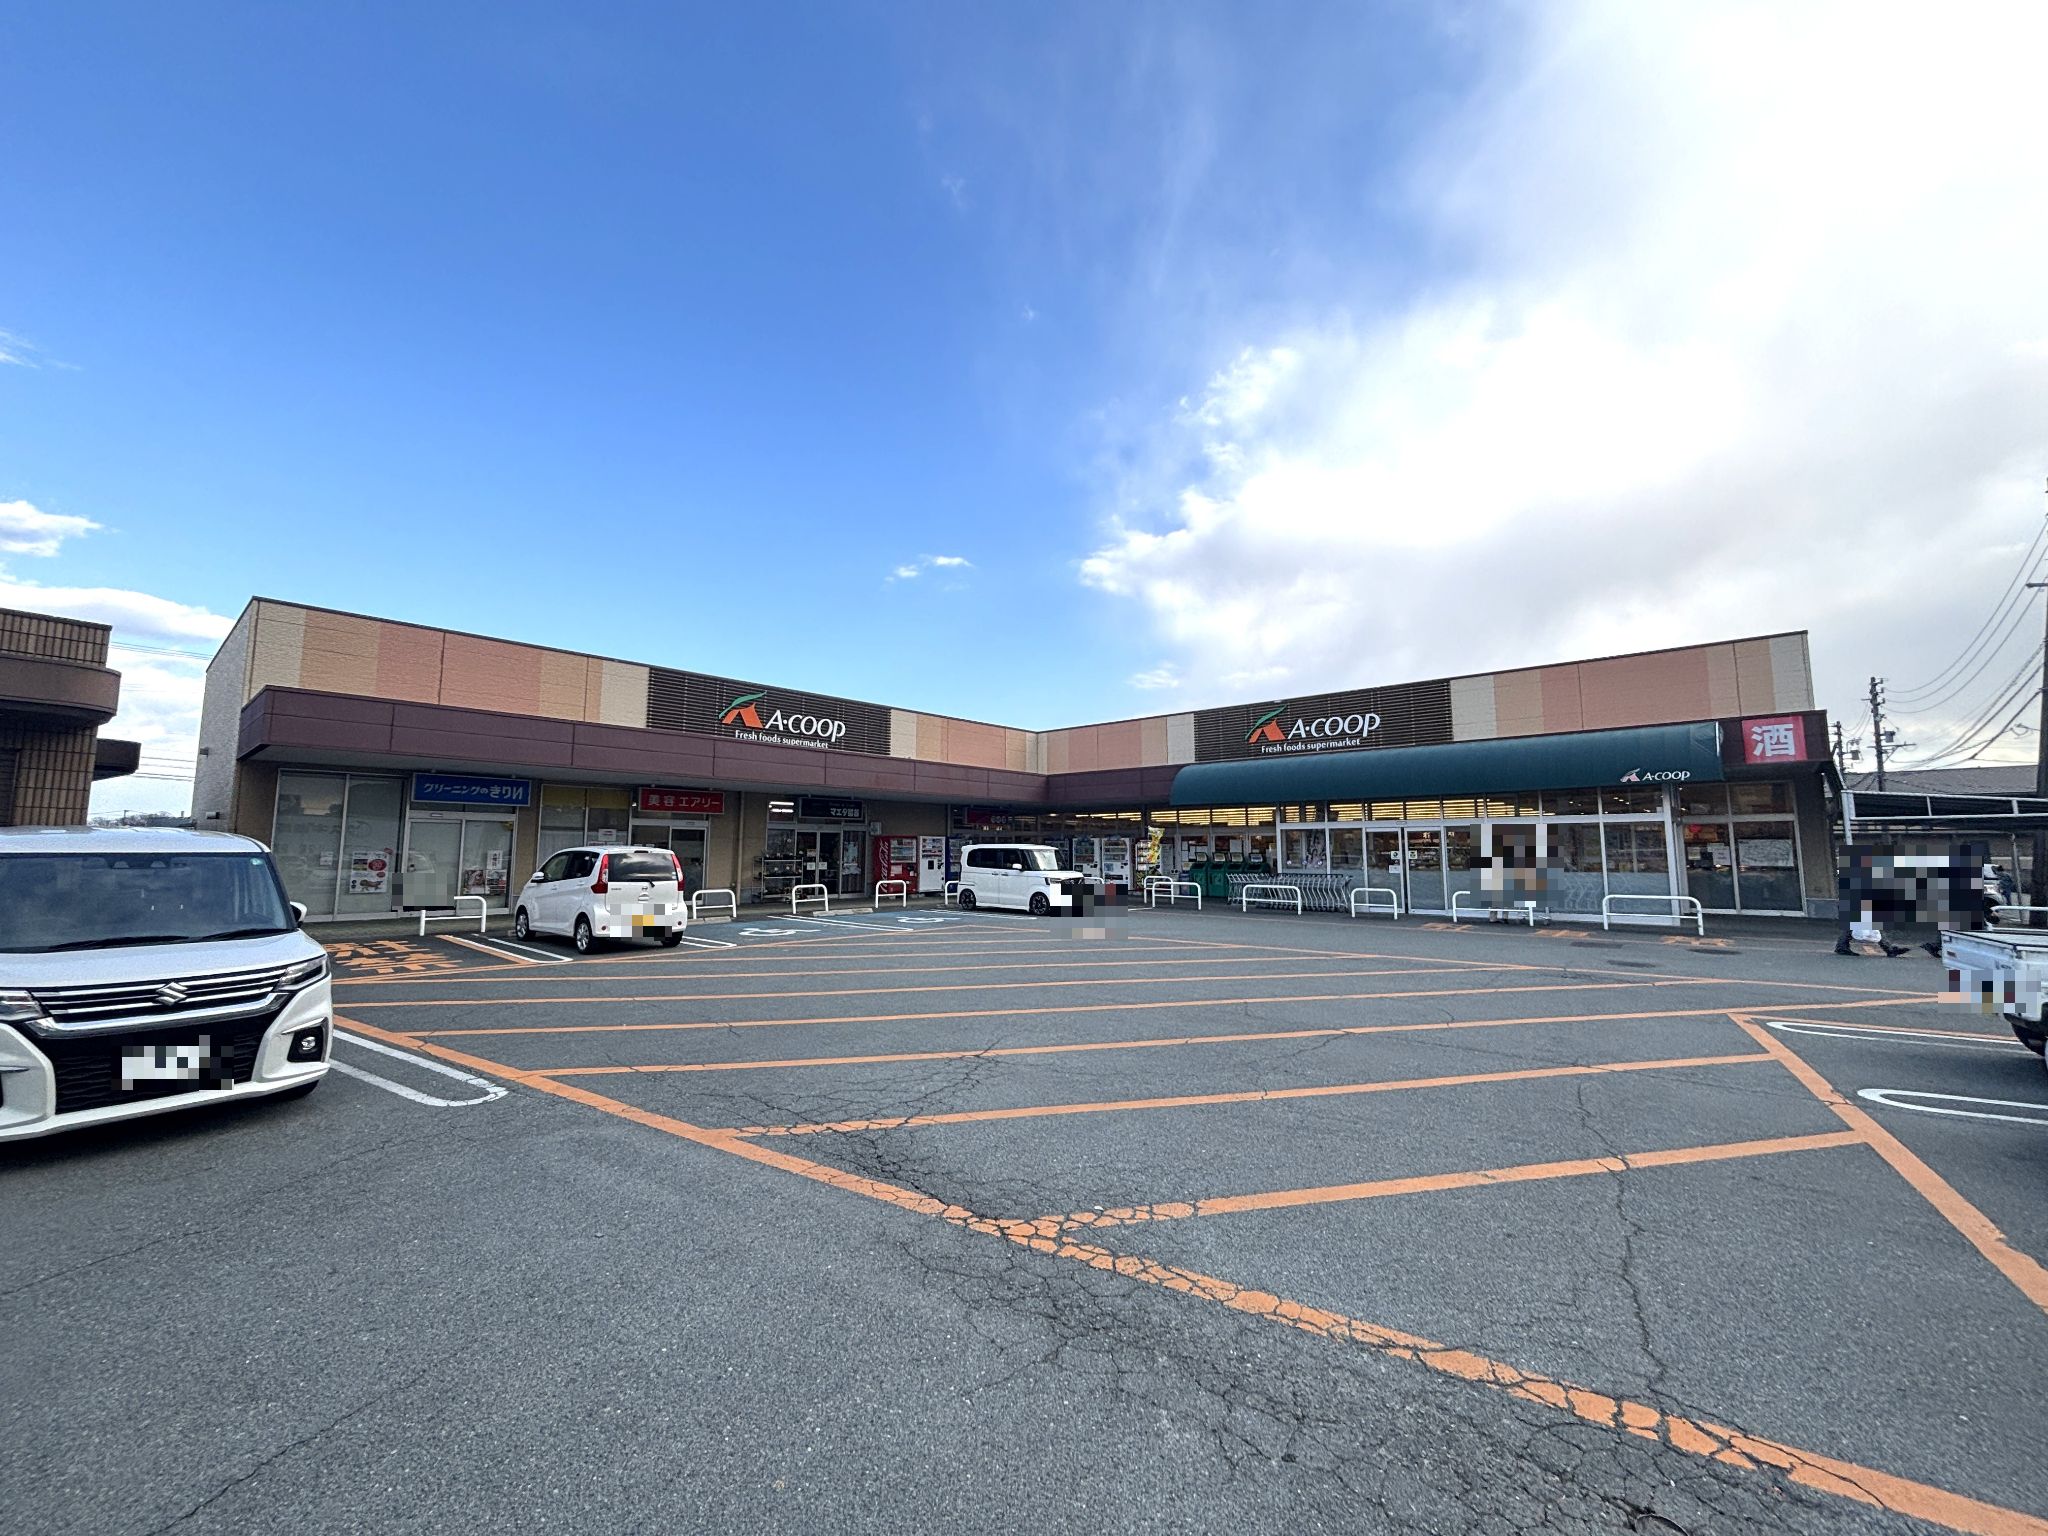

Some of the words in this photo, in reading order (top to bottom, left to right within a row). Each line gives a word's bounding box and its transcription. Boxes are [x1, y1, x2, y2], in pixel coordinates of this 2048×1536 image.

[735, 729, 758, 741] Fresh
[758, 731, 781, 744] foods
[782, 736, 829, 749] supermarket
[1261, 744, 1282, 754] Fresh
[1283, 741, 1306, 752] foods
[1306, 738, 1361, 752] supermarket
[1750, 723, 1796, 758] 酒
[679, 796, 720, 808] エアリー
